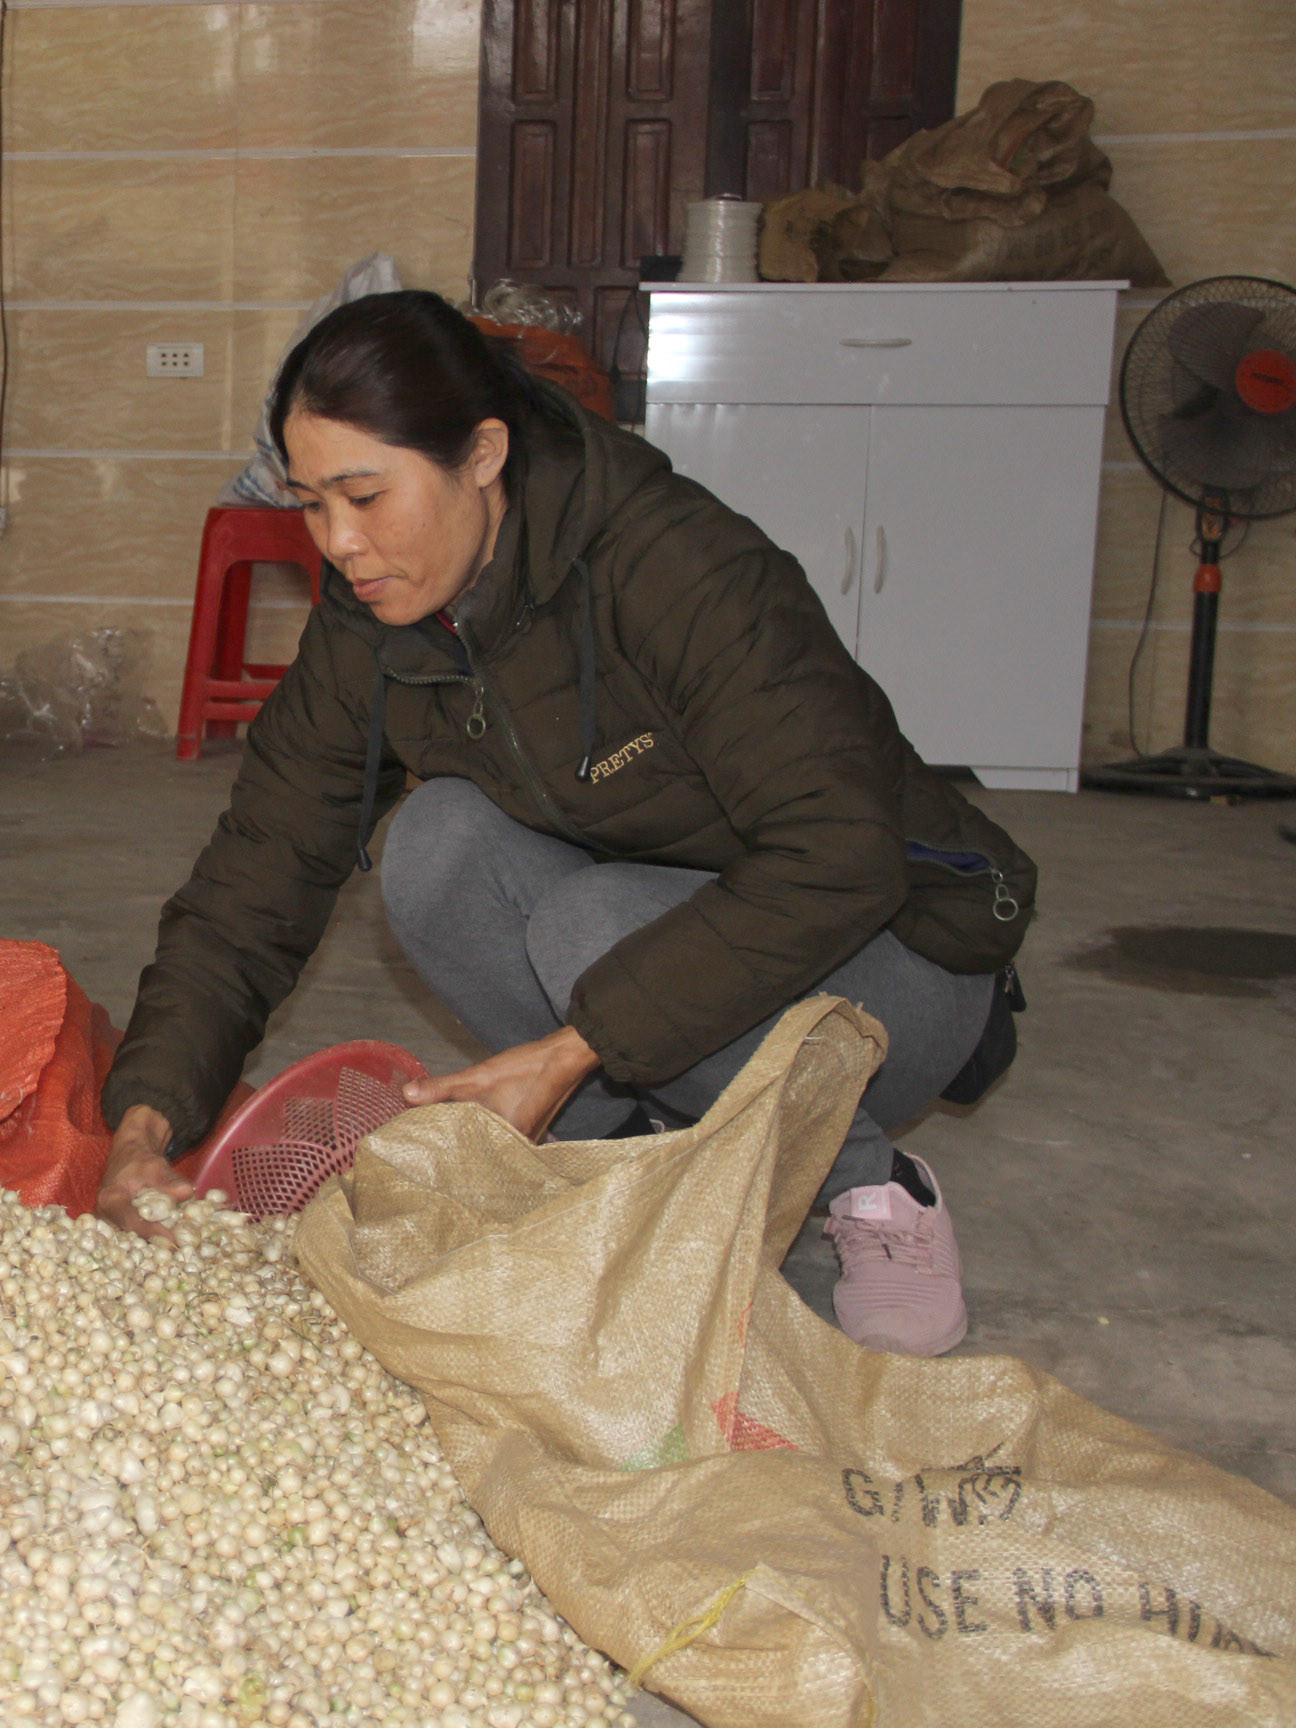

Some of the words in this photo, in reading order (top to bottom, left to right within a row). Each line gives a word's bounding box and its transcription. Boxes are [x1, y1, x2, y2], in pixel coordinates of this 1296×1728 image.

[590, 732, 654, 784] PRETYS
[858, 1192, 877, 1210] R
[881, 1554, 988, 1640] USE
[1013, 1567, 1103, 1632] NO
